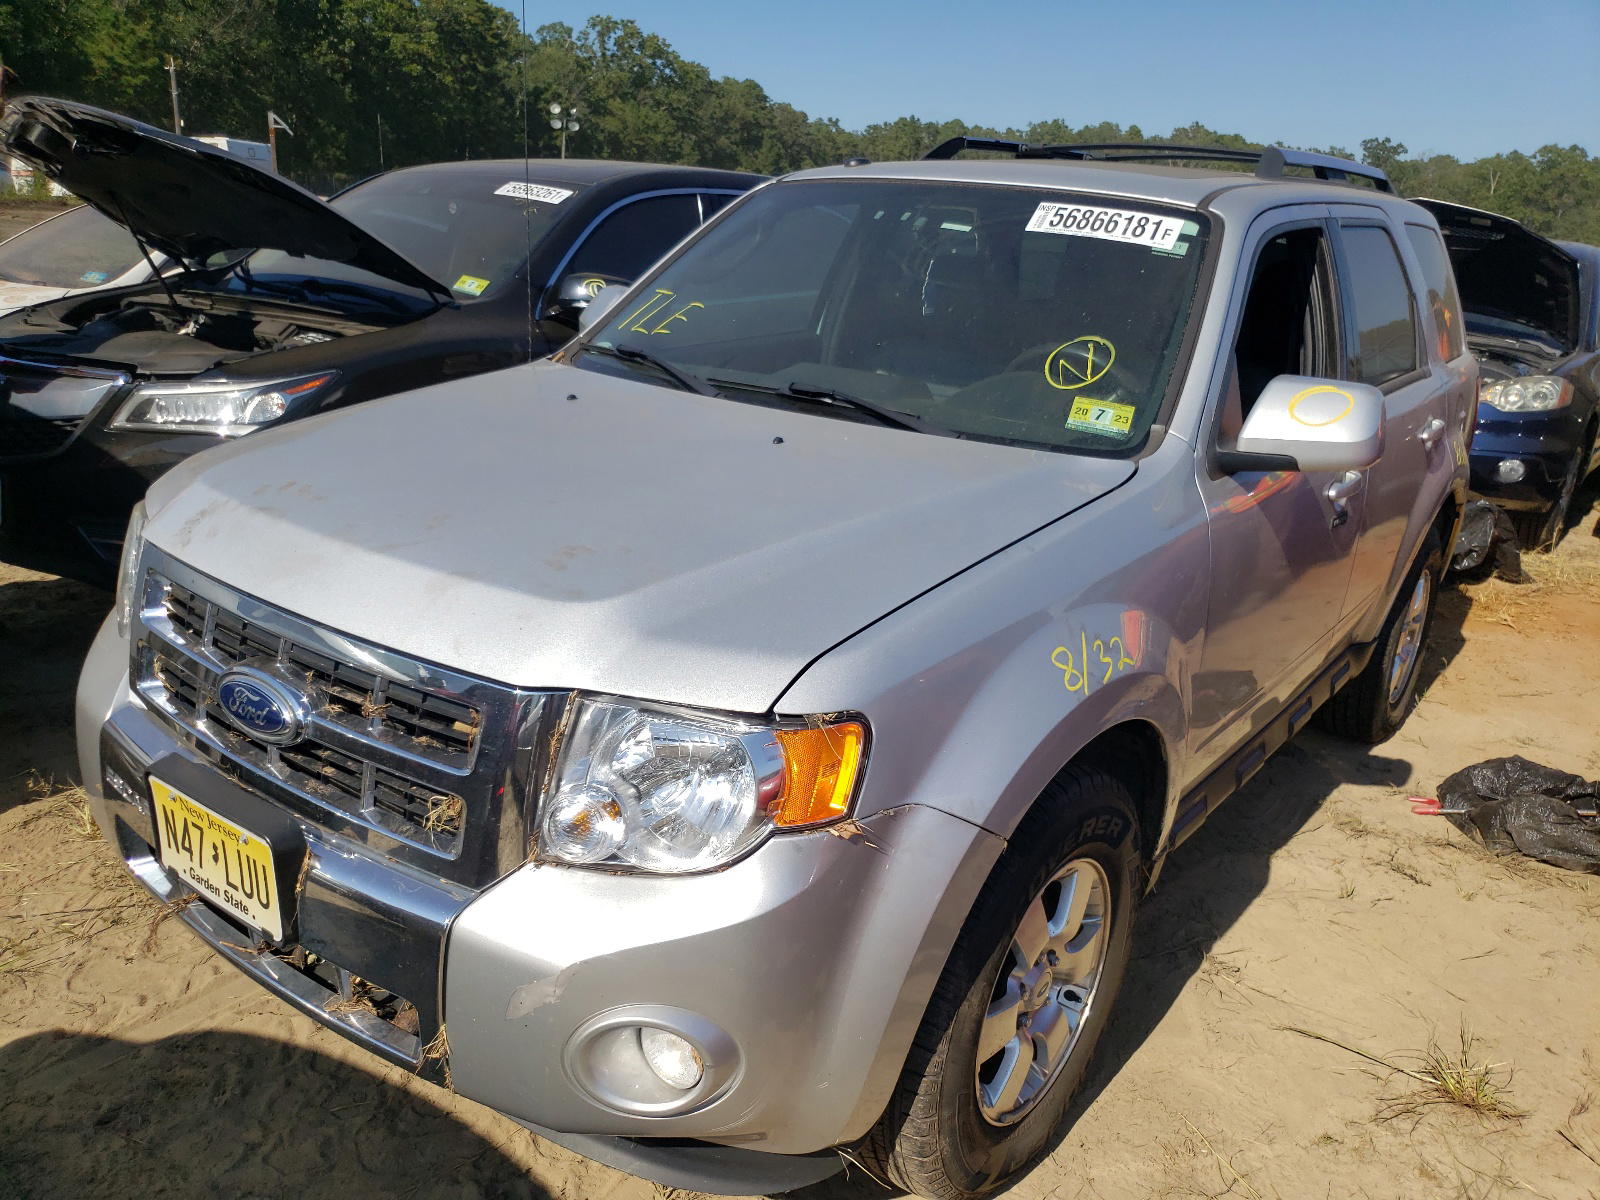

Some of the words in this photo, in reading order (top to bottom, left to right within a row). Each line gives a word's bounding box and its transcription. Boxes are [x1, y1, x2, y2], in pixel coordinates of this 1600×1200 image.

[1038, 203, 1056, 212] INSP
[1049, 206, 1164, 241] 56866181
[1161, 228, 1174, 240] F
[1074, 406, 1089, 416] 20
[1094, 408, 1106, 421] 7
[1114, 414, 1129, 424] 23
[229, 686, 270, 726] Ford
[178, 797, 205, 823] New
[206, 811, 242, 846] Jersey
[161, 803, 205, 869] N47
[221, 839, 270, 910] LUU
[189, 866, 221, 897] Garden
[223, 890, 249, 916] State
